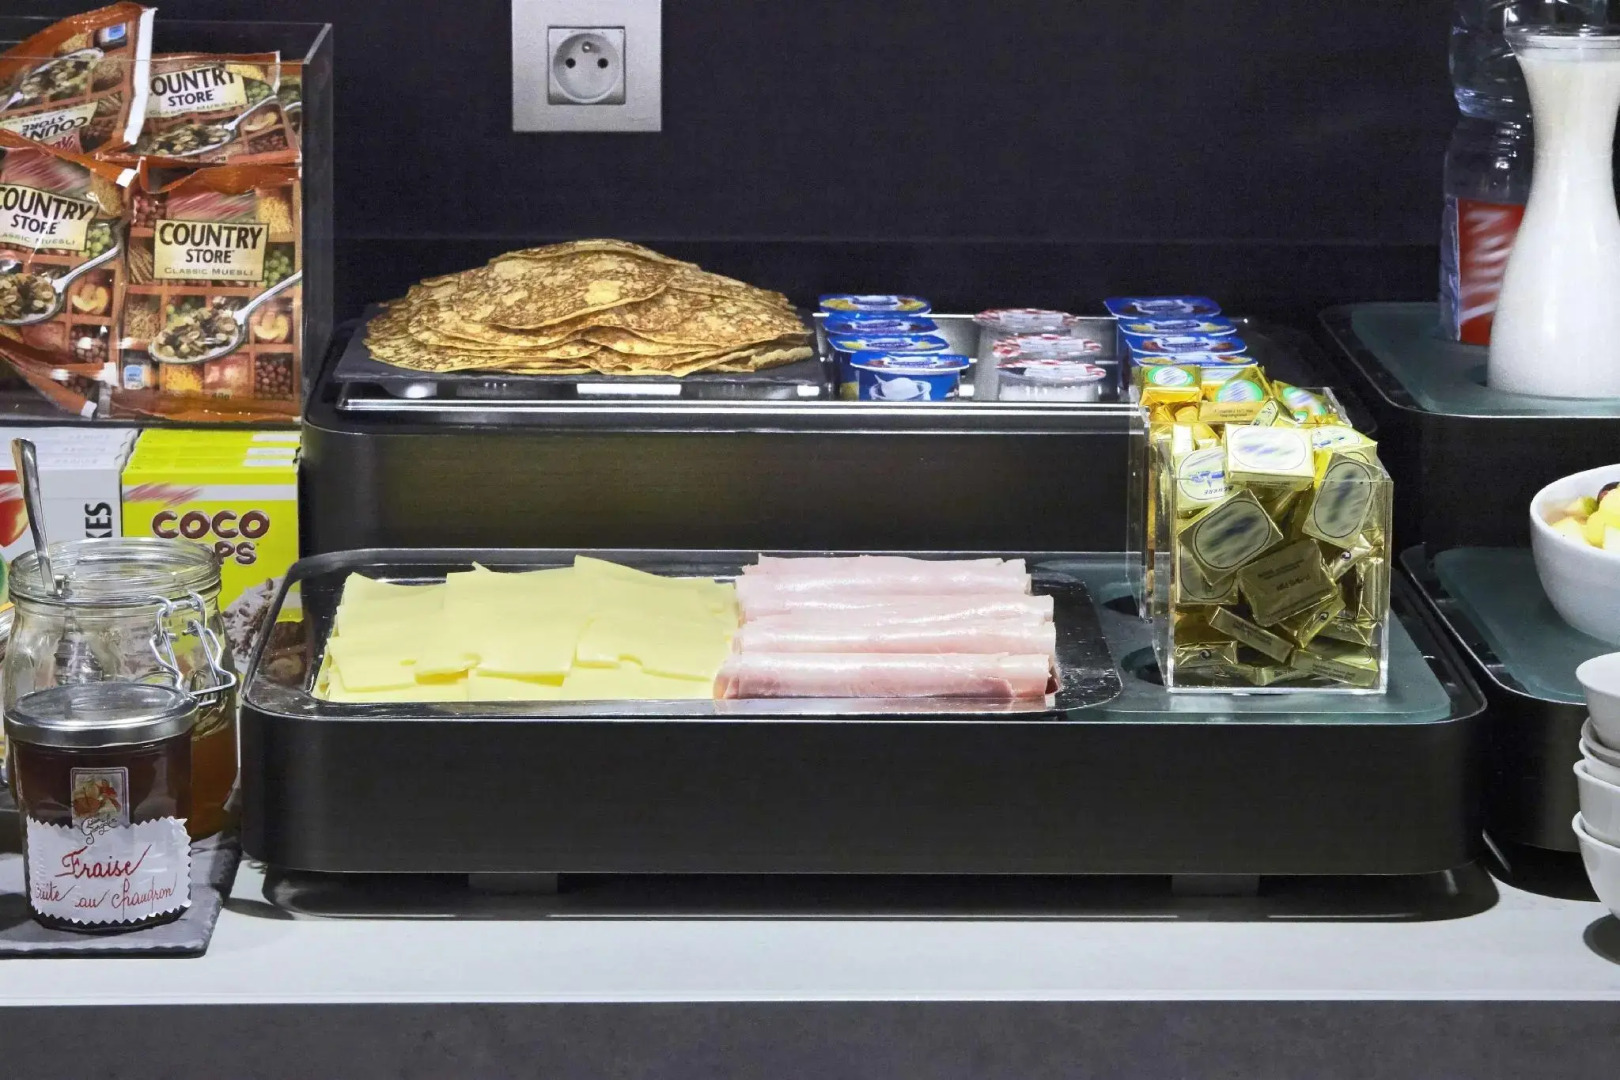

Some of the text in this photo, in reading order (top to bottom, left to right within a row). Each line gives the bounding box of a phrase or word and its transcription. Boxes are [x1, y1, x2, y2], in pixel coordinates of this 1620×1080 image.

[150, 67, 235, 97] OUNTRY
[168, 90, 214, 107] STORE
[22, 116, 88, 140] COUN
[159, 222, 263, 250] COUNTRY
[185, 248, 232, 264] STORE
[164, 267, 254, 277] CLASSIC MUESLI
[152, 509, 271, 540] COCO
[214, 540, 257, 565] PS
[55, 844, 152, 879] Fraise
[75, 888, 111, 908] au
